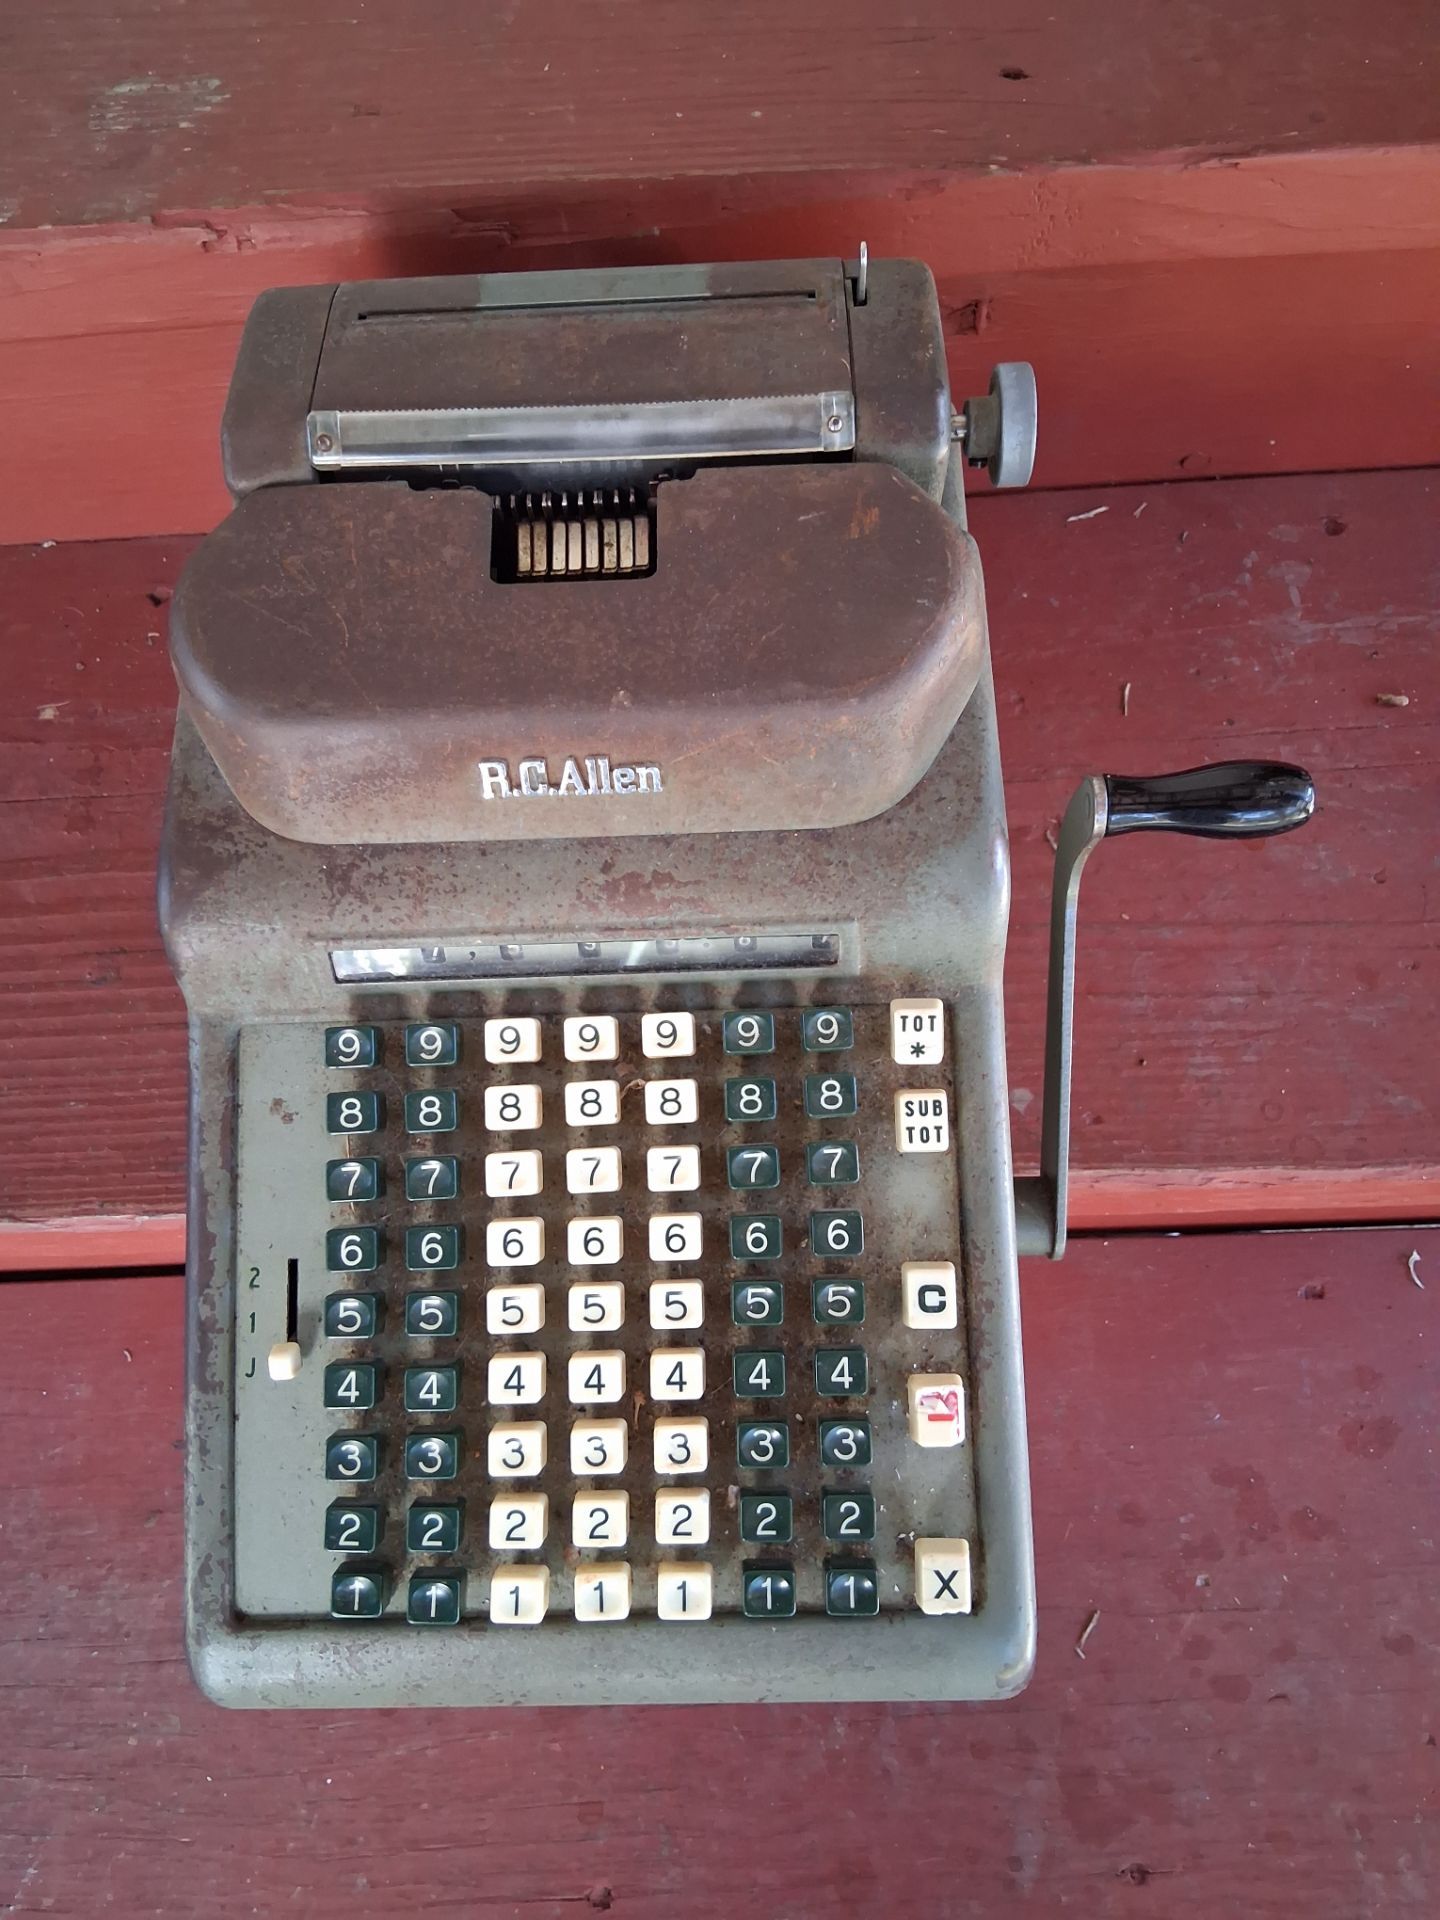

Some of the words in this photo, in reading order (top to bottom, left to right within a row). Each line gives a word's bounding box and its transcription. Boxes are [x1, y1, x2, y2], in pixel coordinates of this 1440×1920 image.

[478, 755, 664, 800] R.C.Allen
[578, 1023, 600, 1052] 9
[656, 1020, 678, 1048] 9
[737, 1017, 760, 1047] 9
[817, 1015, 839, 1044] 9
[901, 1016, 937, 1032] TOT
[338, 1033, 360, 1062] 9
[420, 1030, 441, 1060] 9
[499, 1026, 521, 1054] 9
[499, 1093, 521, 1122] 8
[580, 1088, 602, 1117] 8
[659, 1087, 682, 1116] 8
[739, 1083, 762, 1114] 8
[820, 1080, 843, 1110] 8
[904, 1100, 943, 1117] SUB
[340, 1098, 362, 1127] 8
[419, 1096, 442, 1126] 8
[905, 1126, 943, 1144] TOT
[501, 1160, 520, 1190] 7
[581, 1157, 601, 1186] 7
[663, 1155, 682, 1184] 7
[743, 1152, 765, 1182] 7
[823, 1148, 842, 1179] 7
[340, 1165, 362, 1196] 7
[420, 1164, 441, 1195] 7
[421, 1232, 443, 1263] 6
[502, 1229, 523, 1258] 6
[583, 1227, 604, 1256] 6
[665, 1223, 686, 1253] 6
[745, 1222, 768, 1253] 6
[827, 1219, 849, 1250] 6
[340, 1235, 362, 1265] 6
[249, 1267, 260, 1288] 2
[501, 1296, 524, 1326] 5
[583, 1294, 606, 1324] 5
[664, 1291, 687, 1321] 5
[746, 1289, 770, 1318] 5
[827, 1287, 851, 1317] 5
[917, 1284, 947, 1313] C
[249, 1312, 256, 1333] 1
[337, 1302, 362, 1332] 5
[419, 1300, 443, 1330] 5
[245, 1357, 256, 1378] J
[503, 1365, 525, 1396] 4
[584, 1364, 605, 1395] 4
[665, 1361, 687, 1392] 4
[748, 1358, 771, 1390] 4
[830, 1356, 853, 1389] 4
[337, 1370, 360, 1403] 4
[419, 1375, 441, 1405] 4
[418, 1442, 442, 1473] 3
[502, 1437, 524, 1469] 3
[584, 1436, 607, 1467] 3
[668, 1433, 690, 1464] 3
[750, 1429, 774, 1462] 3
[833, 1428, 857, 1460] 3
[337, 1445, 362, 1476] 3
[339, 1514, 360, 1546] 2
[421, 1513, 443, 1546] 2
[505, 1510, 526, 1541] 2
[588, 1507, 609, 1539] 2
[672, 1505, 692, 1536] 2
[756, 1503, 777, 1535] 2
[839, 1501, 860, 1534] 2
[350, 1580, 359, 1611] 1
[595, 1581, 604, 1613] 1
[678, 1580, 687, 1612] 1
[764, 1577, 773, 1610] 1
[846, 1576, 856, 1609] 1
[934, 1570, 959, 1599] X
[427, 1586, 437, 1618] 1
[509, 1585, 520, 1616] 1
